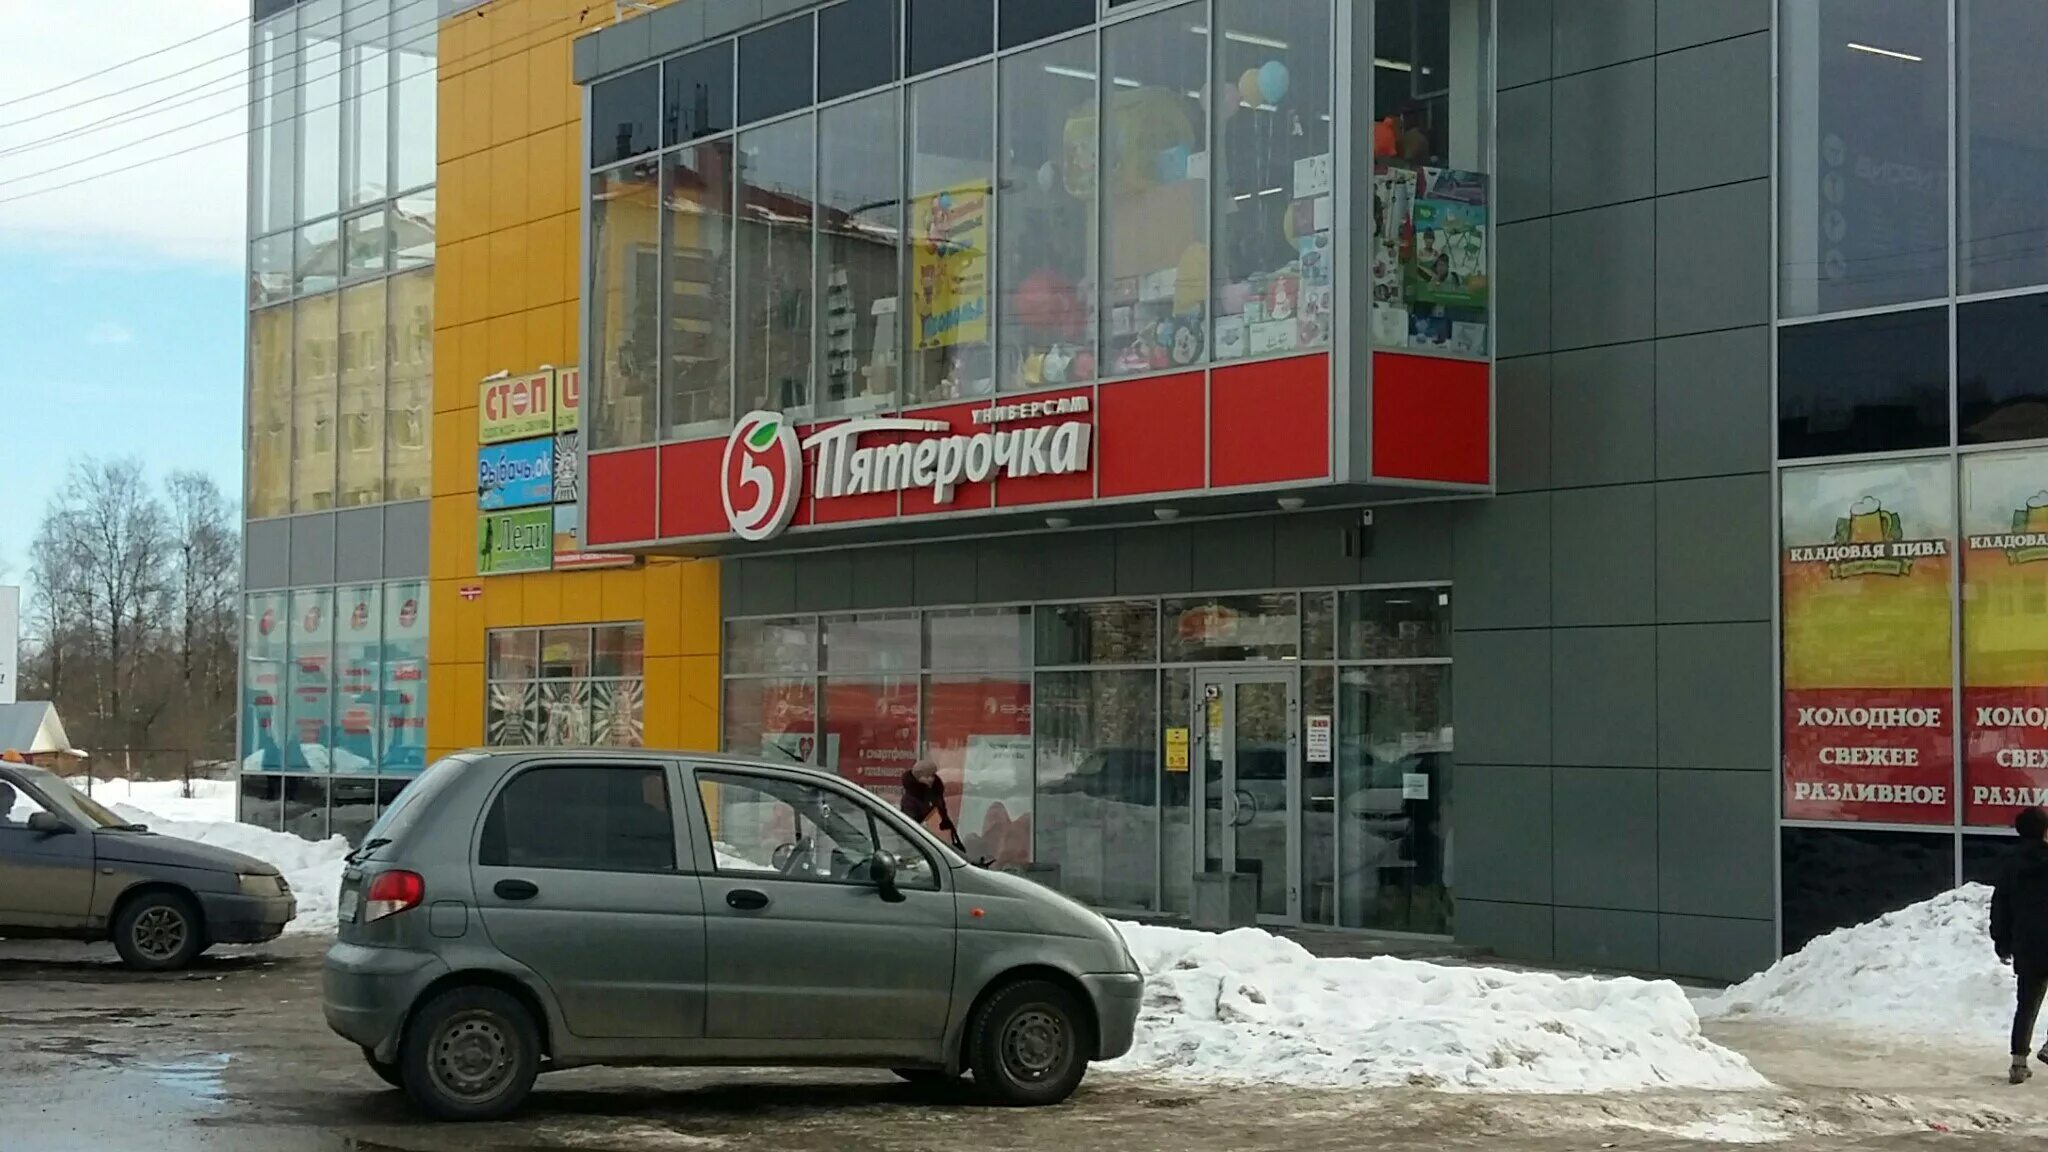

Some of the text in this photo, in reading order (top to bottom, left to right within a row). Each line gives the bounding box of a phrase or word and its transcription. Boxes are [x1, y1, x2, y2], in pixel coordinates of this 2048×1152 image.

[486, 376, 547, 421] СТОП
[972, 396, 1090, 424] УНИВЕРСАМ
[497, 517, 547, 552] Леди
[1790, 541, 1947, 562] КЛАДОВАЯ ПИВА
[1798, 708, 1942, 728] ХОЛОДНОЕ
[1819, 747, 1920, 767] СВЕЖЕЕ
[1795, 782, 1947, 805] РАЗЛИВНОЕ
